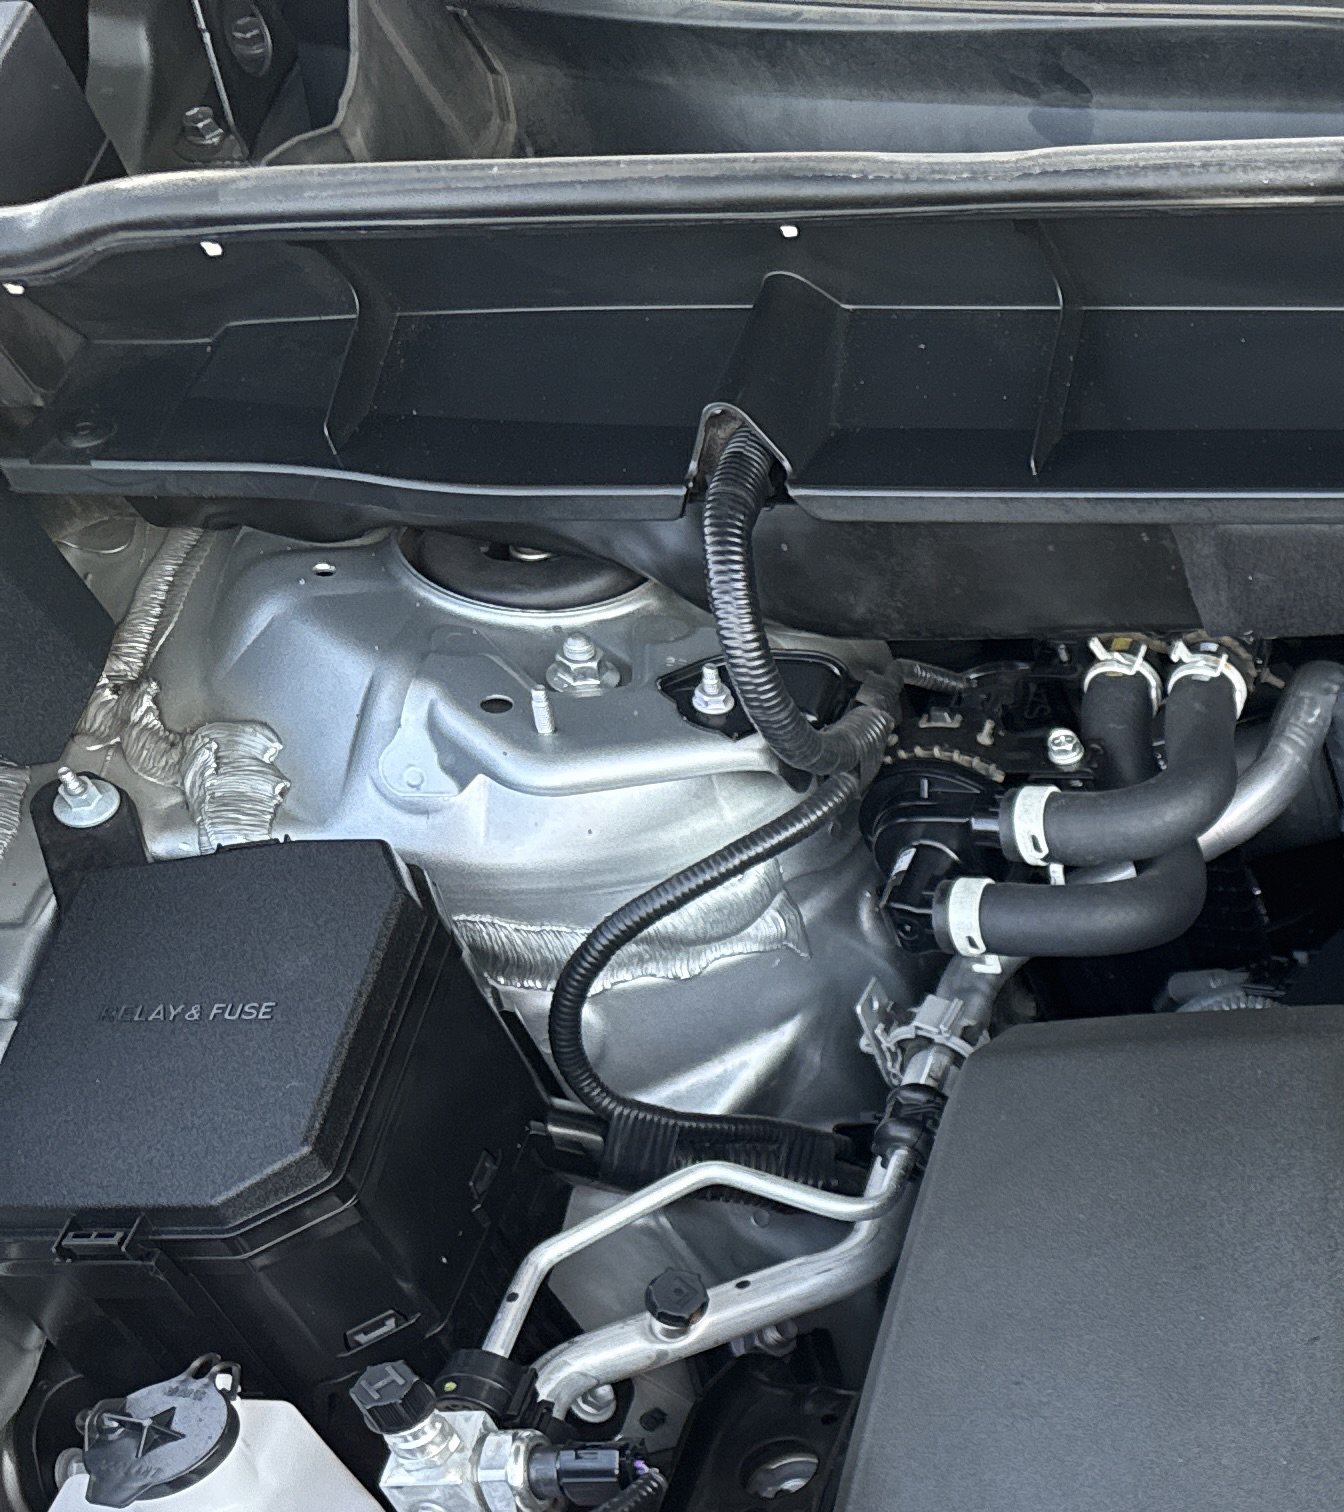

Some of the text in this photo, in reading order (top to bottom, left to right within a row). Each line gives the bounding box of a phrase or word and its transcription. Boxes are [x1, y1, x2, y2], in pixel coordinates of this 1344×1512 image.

[99, 1001, 276, 1021] RELAY & FUSE
